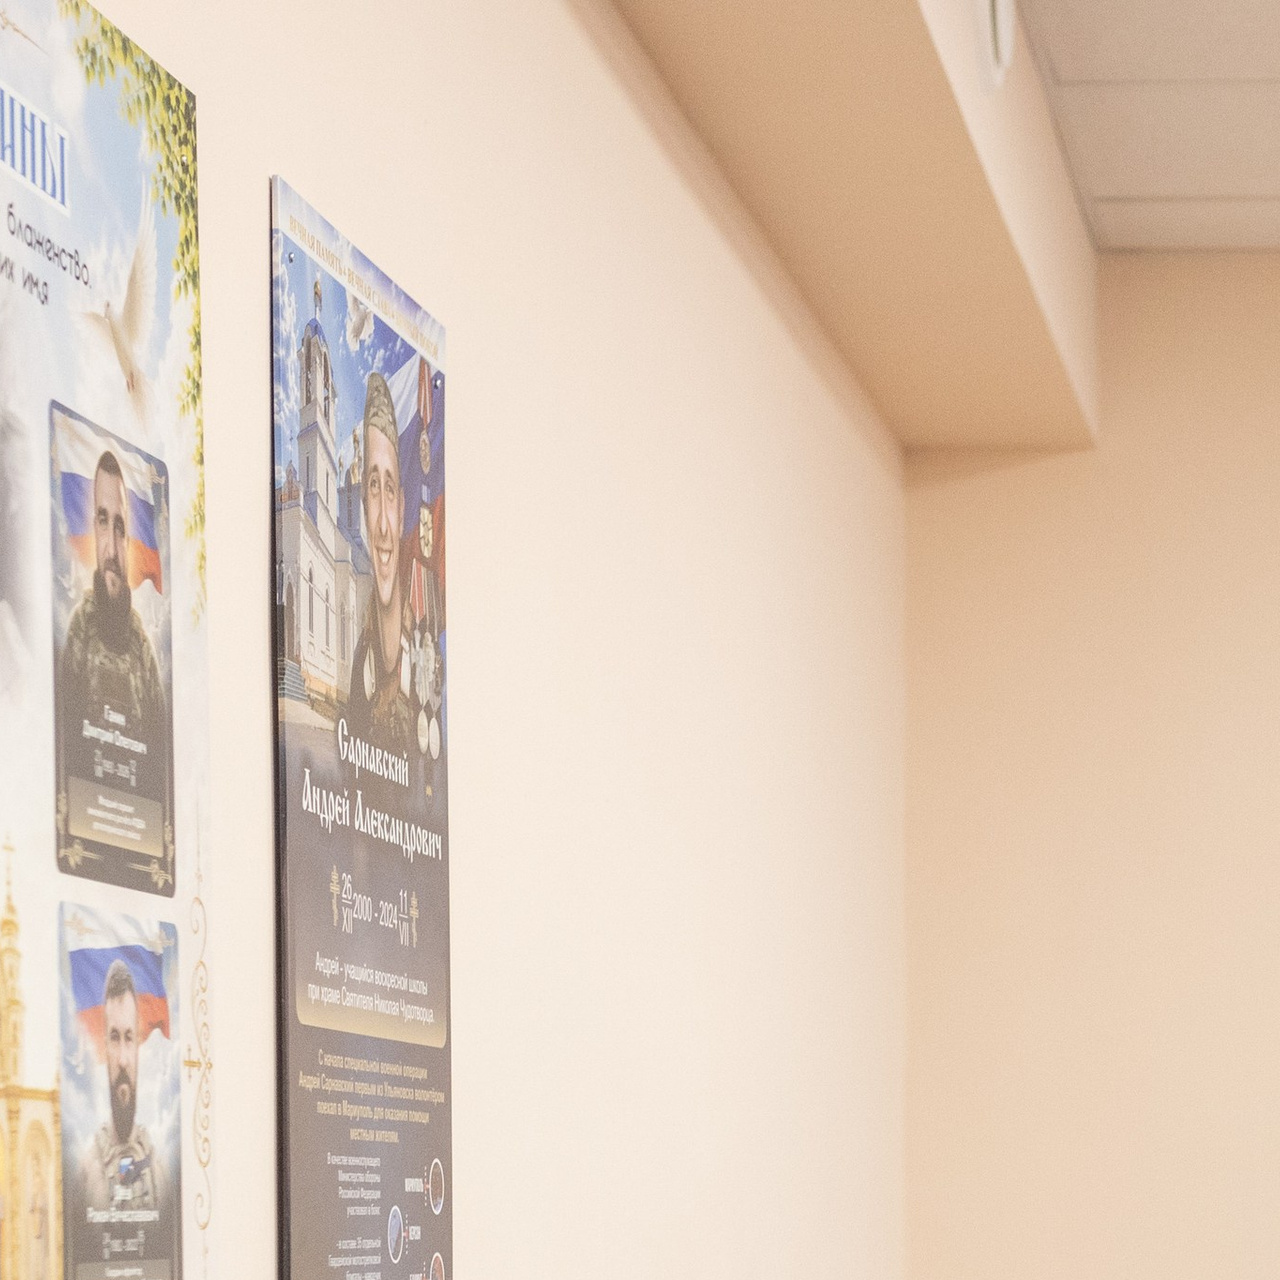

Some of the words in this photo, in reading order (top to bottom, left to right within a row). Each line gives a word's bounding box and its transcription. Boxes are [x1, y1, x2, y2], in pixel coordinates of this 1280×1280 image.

[7, 203, 92, 289] блаженство.
[22, 266, 49, 305] имя
[338, 718, 408, 787] Сарнавский
[302, 768, 350, 834] Андрей
[354, 790, 442, 863] Александрович
[342, 873, 352, 899] 26
[353, 893, 372, 922] 2000
[379, 901, 398, 929] 2024
[315, 951, 339, 979] Андрей
